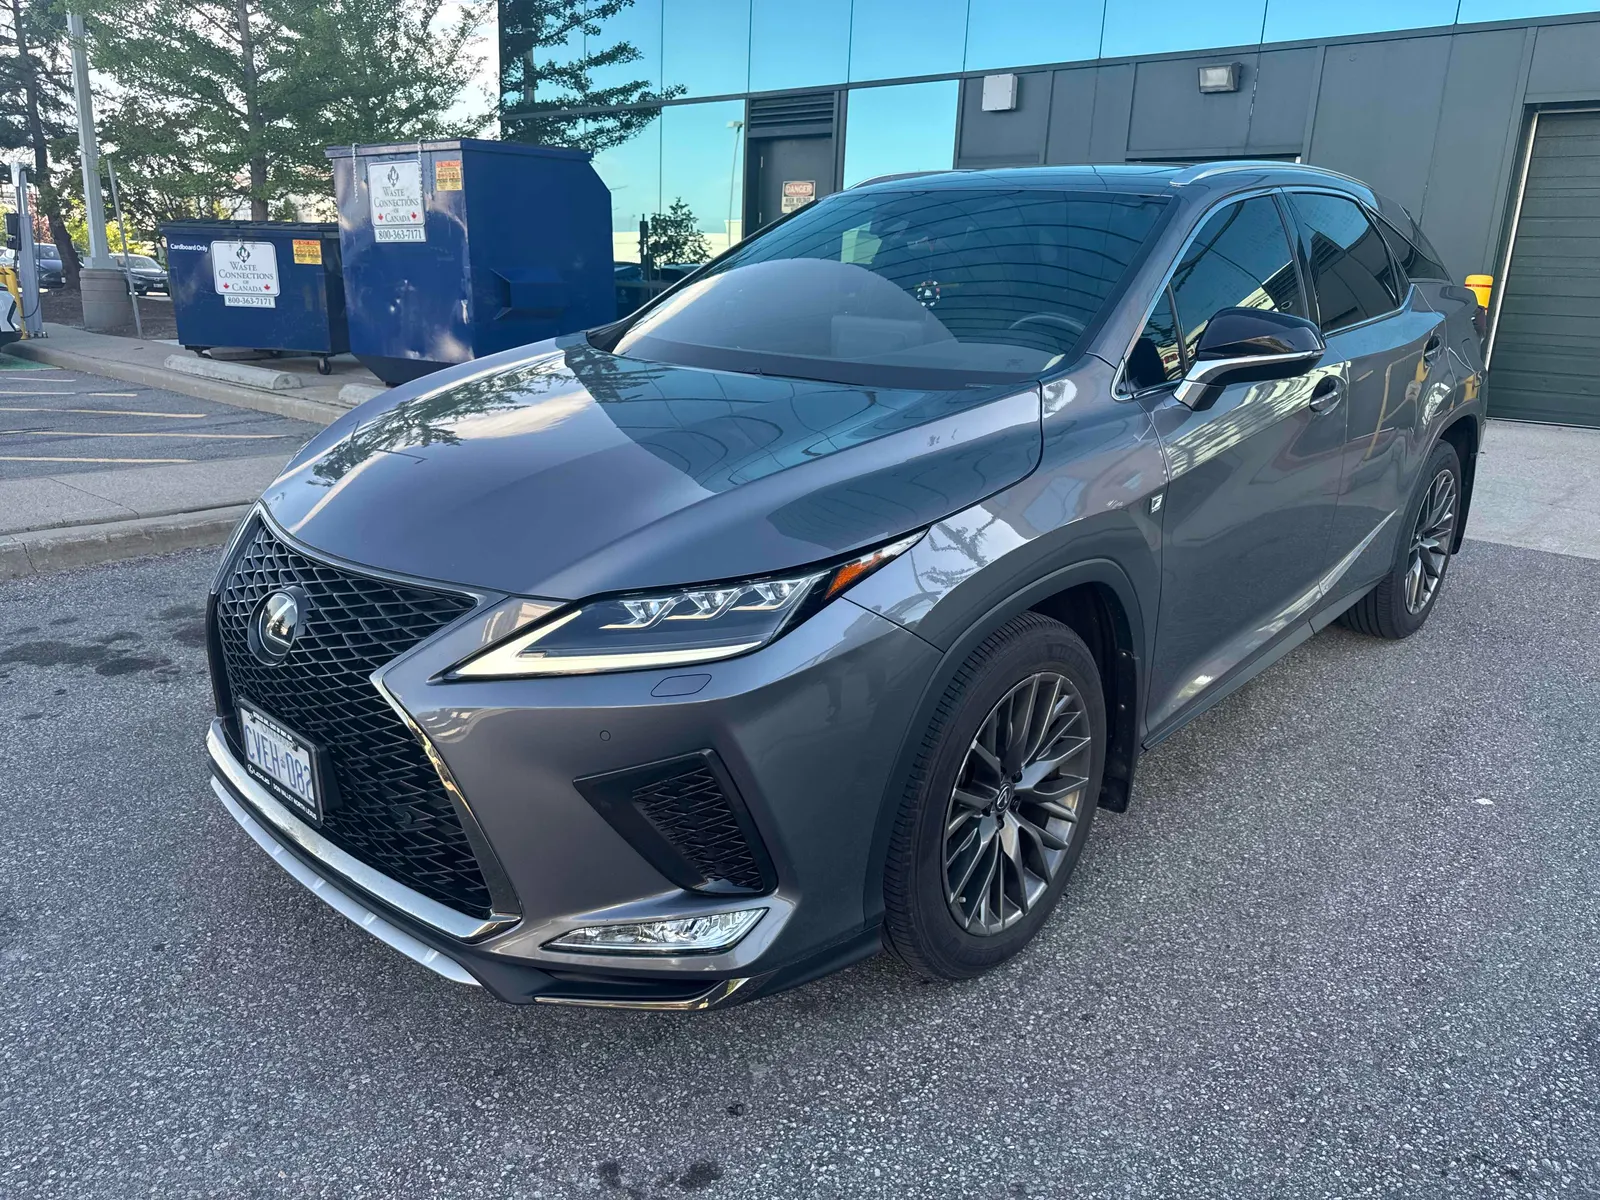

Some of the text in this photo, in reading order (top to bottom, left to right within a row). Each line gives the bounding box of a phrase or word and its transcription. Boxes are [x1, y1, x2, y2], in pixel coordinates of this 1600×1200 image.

[382, 186, 405, 197] WASTE
[785, 183, 812, 194] DANGER
[373, 196, 419, 208] CONNECTIONS
[384, 212, 411, 223] CANADA
[378, 229, 422, 240] 800-363-7171
[170, 243, 208, 253] Cardboard Only
[229, 261, 257, 271] WASTE
[218, 268, 274, 280] CONNECTIONS
[231, 282, 263, 292] CANADA
[227, 297, 272, 306] 800-363-7171
